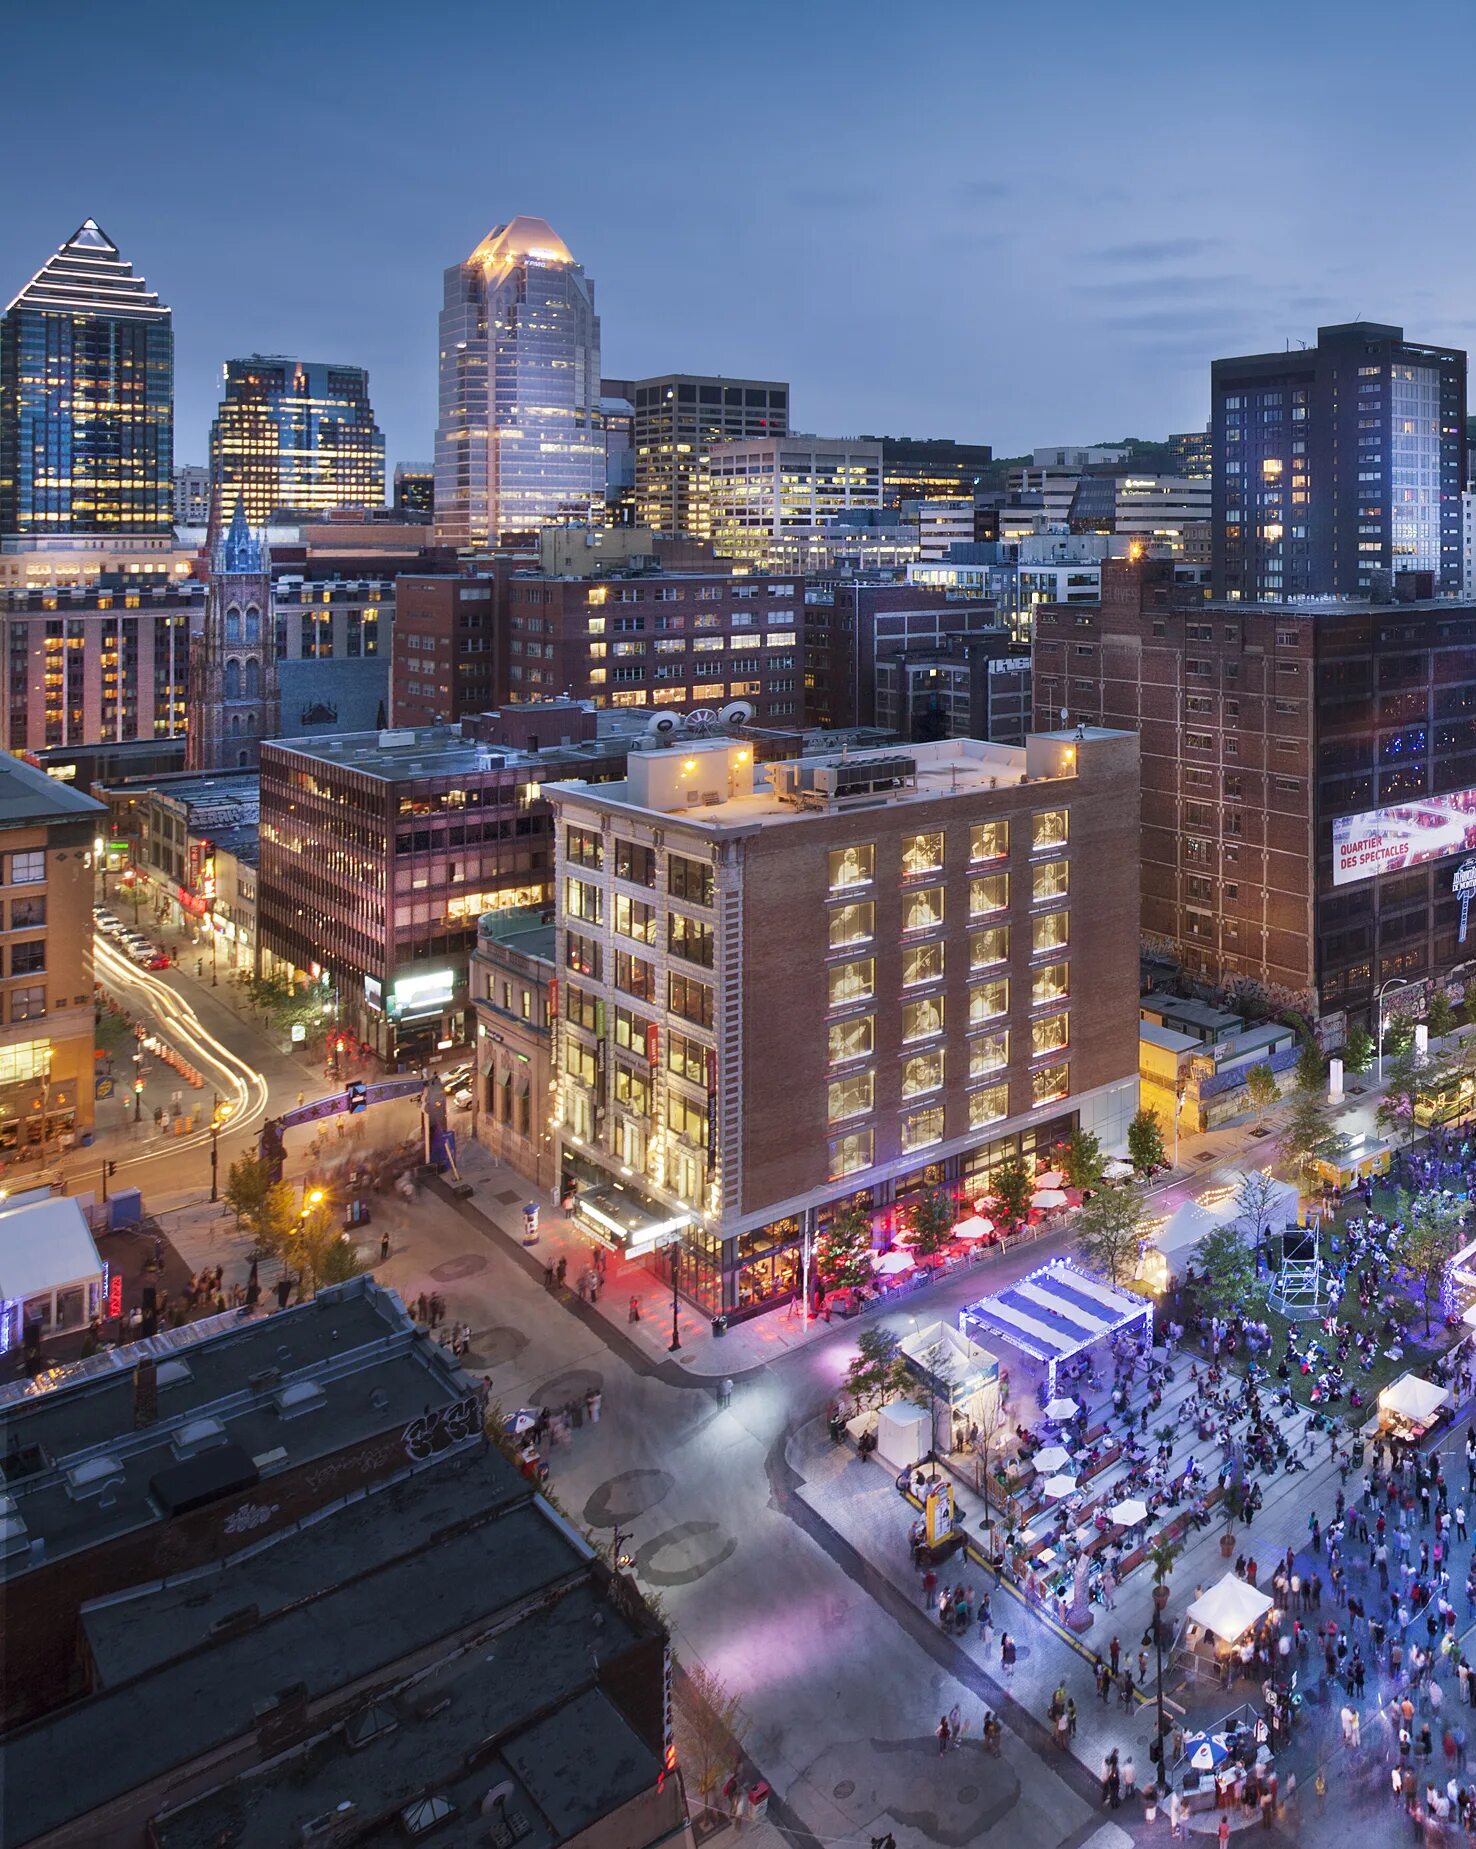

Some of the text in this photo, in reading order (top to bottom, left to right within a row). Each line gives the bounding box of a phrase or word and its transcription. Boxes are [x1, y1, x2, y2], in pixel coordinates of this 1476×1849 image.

[1340, 836, 1382, 856] QUARTIER
[1341, 843, 1409, 870] DES SPECTACLES
